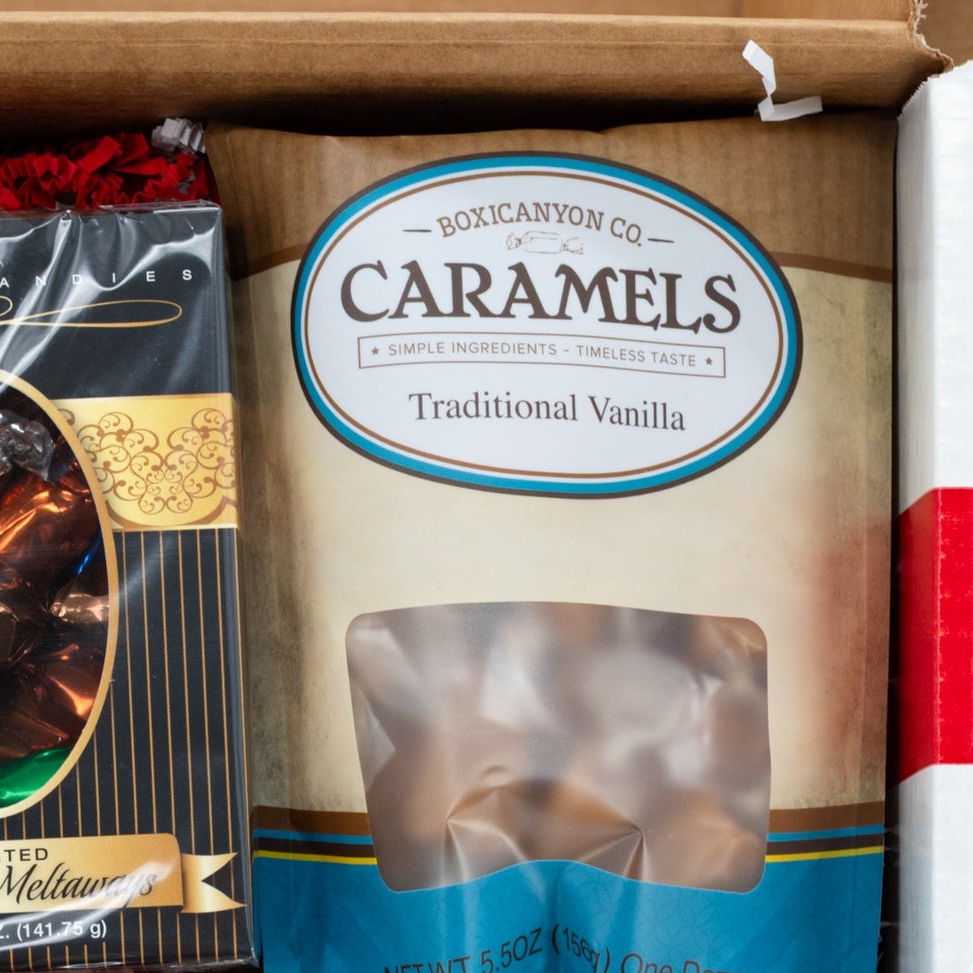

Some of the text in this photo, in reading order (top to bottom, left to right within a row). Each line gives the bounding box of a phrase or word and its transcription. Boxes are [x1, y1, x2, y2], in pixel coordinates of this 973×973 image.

[437, 201, 643, 248] BOXICANYON CO.
[340, 259, 741, 335] CARAMELS
[388, 341, 696, 367] SIMPLE INGREDIENTS TIMELESS TASTE
[409, 390, 686, 432] Traditional Vanilla
[17, 921, 84, 941] (141.75
[89, 920, 108, 940] g)
